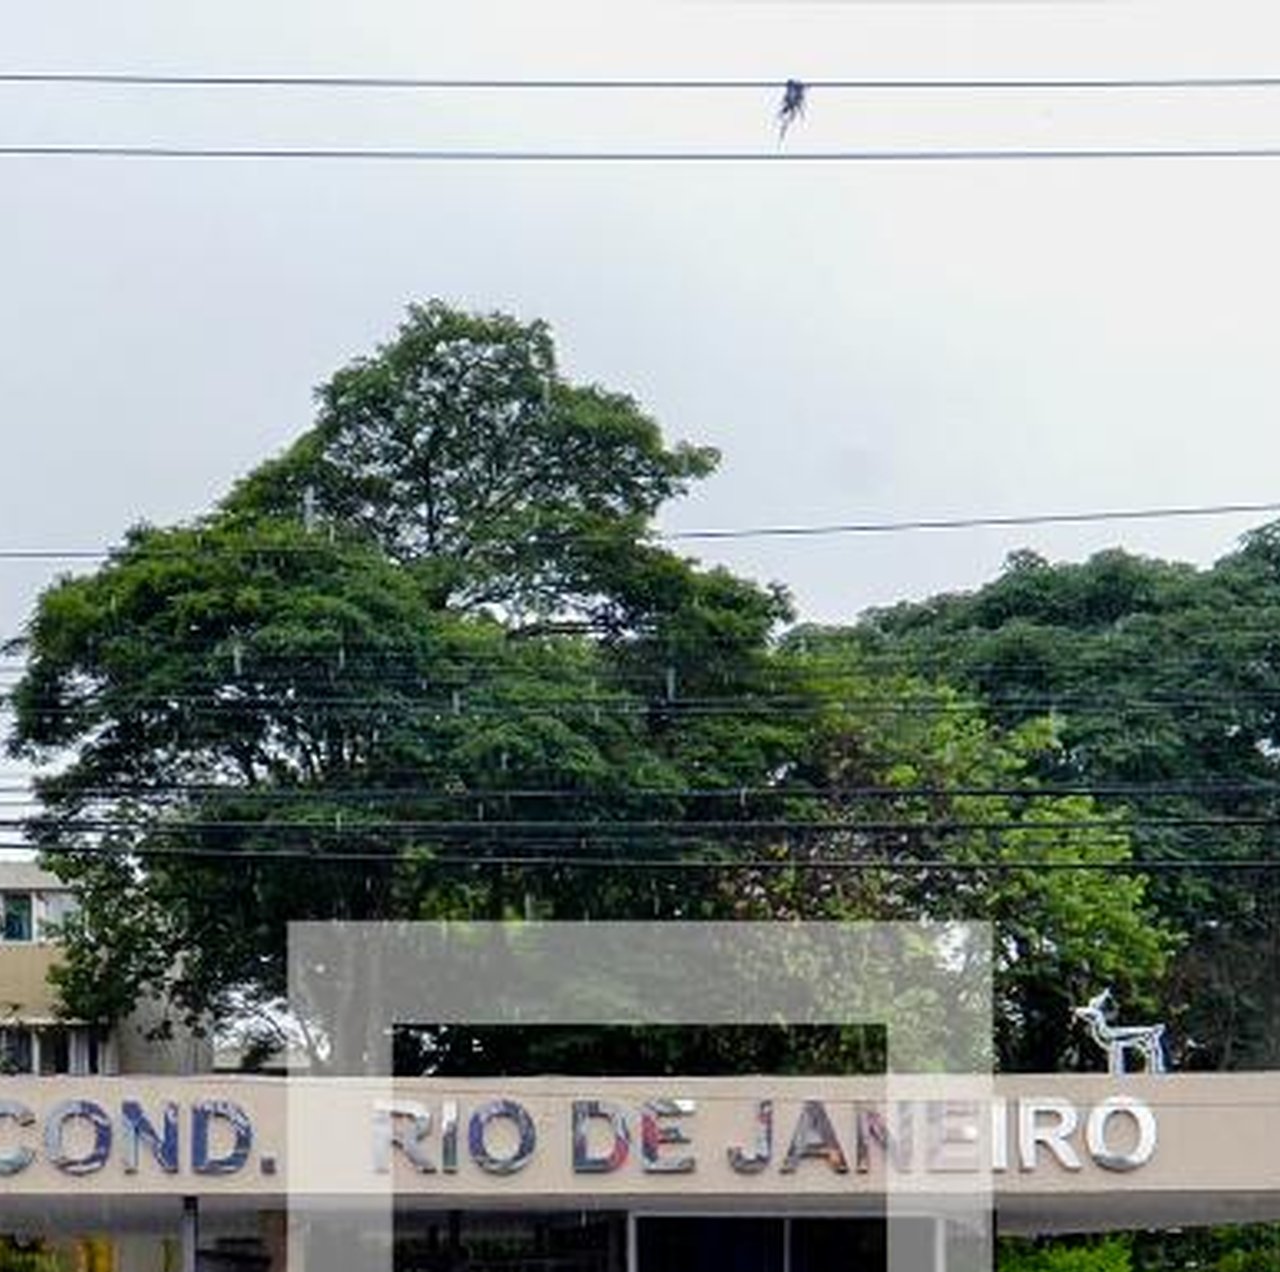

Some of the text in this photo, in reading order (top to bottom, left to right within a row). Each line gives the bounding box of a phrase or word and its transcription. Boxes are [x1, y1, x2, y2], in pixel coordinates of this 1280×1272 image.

[373, 1098, 537, 1176] RIO
[571, 1099, 697, 1174] DE
[727, 1095, 1158, 1174] JANEIRO
